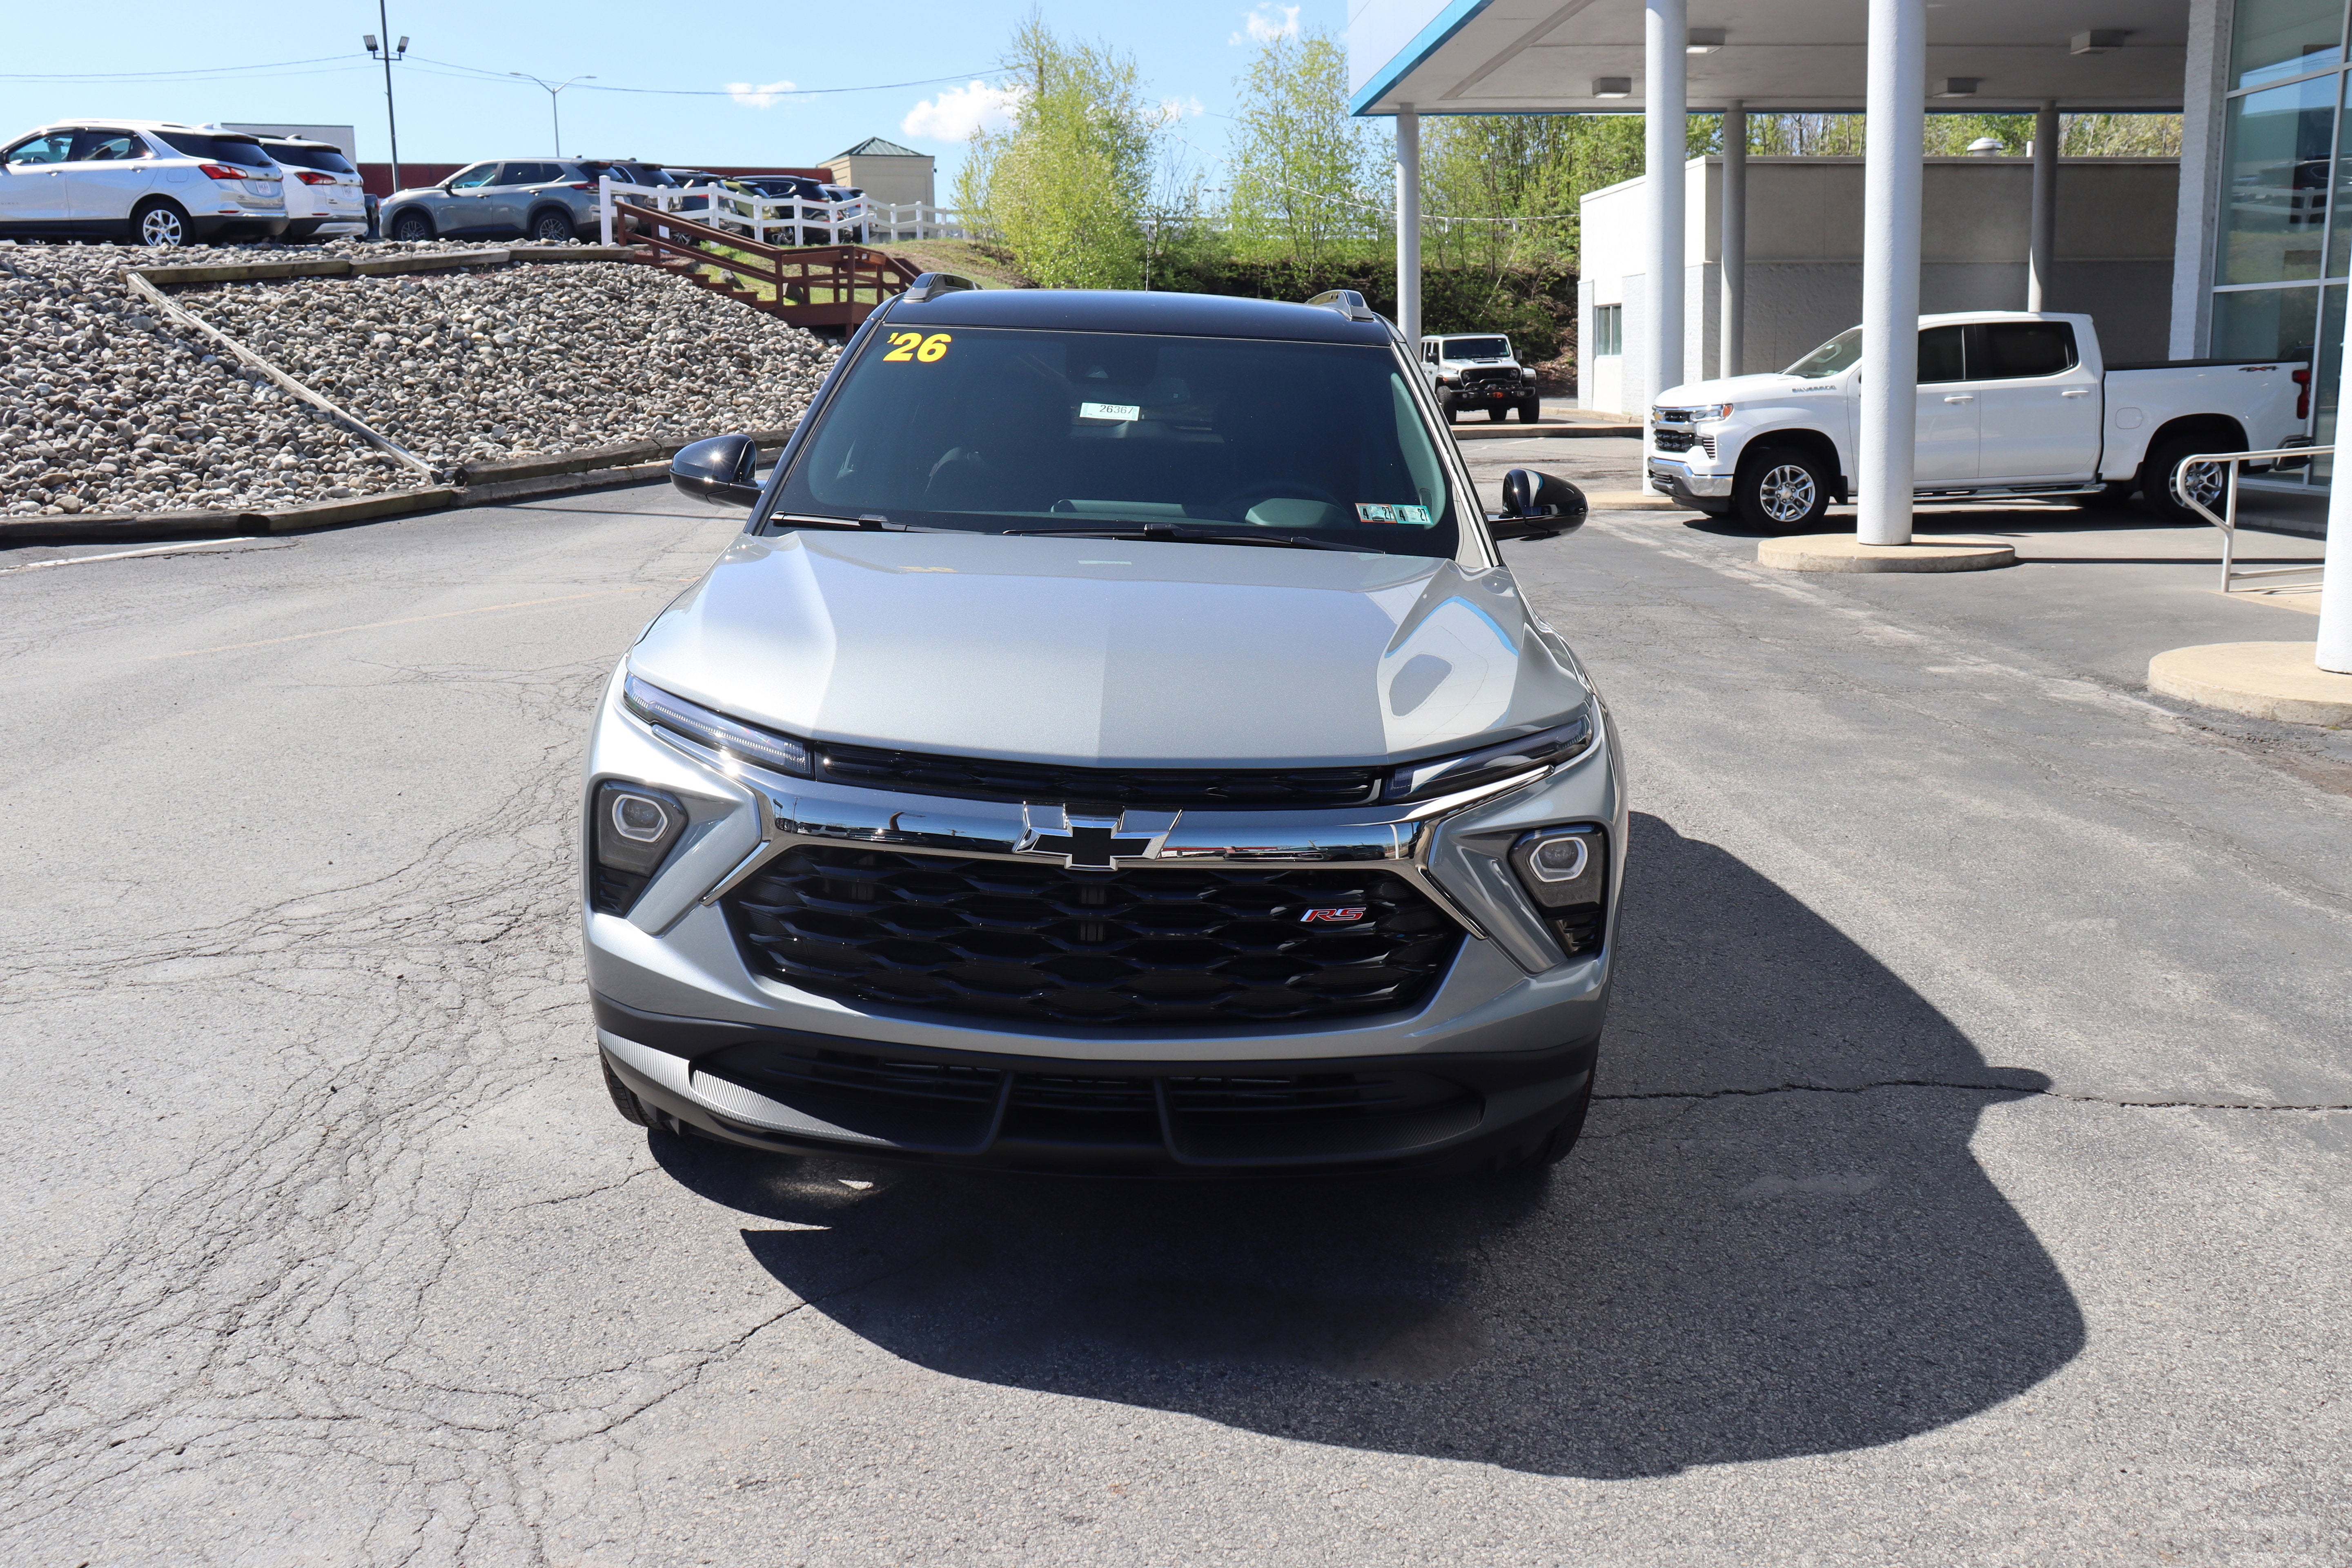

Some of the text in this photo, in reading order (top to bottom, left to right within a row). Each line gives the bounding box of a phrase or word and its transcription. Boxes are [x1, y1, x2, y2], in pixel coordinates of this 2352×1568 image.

[883, 332, 952, 362] '26
[1100, 405, 1134, 414] 26367
[1363, 507, 1392, 520] 4 27
[1399, 508, 1428, 522] 4 27
[1300, 907, 1366, 922] RS
